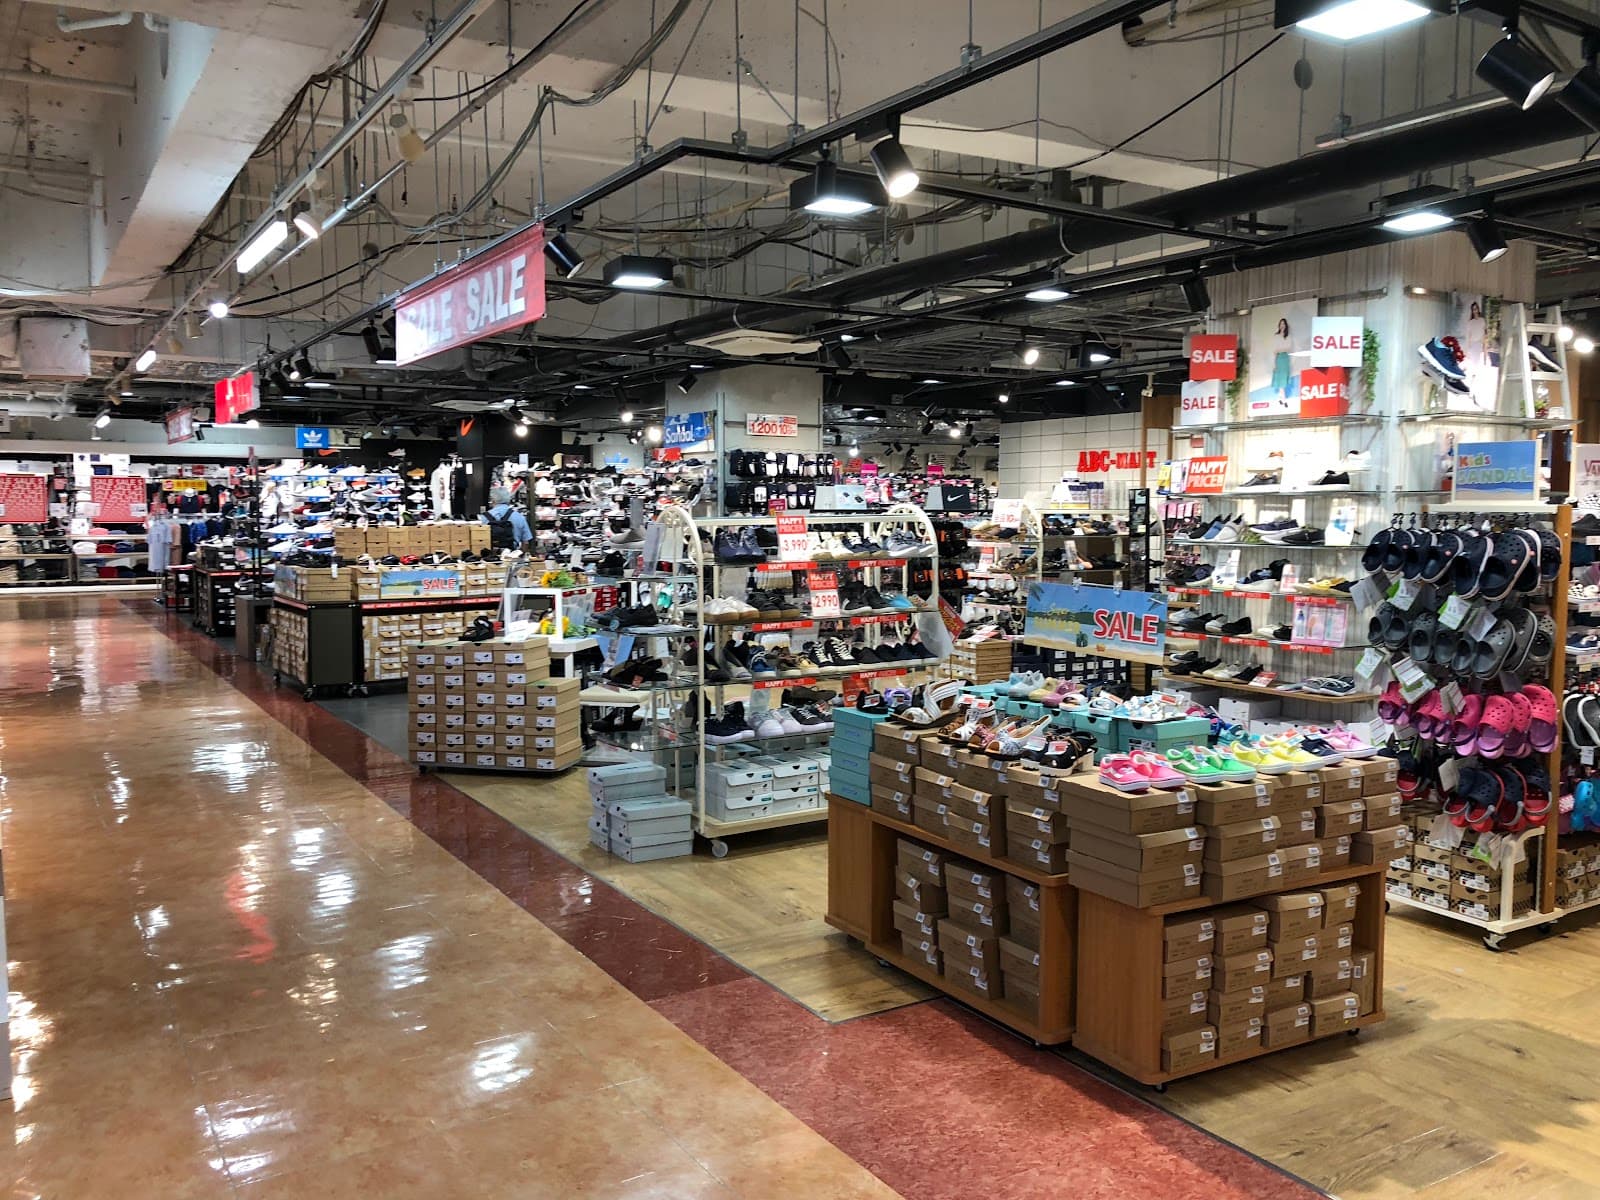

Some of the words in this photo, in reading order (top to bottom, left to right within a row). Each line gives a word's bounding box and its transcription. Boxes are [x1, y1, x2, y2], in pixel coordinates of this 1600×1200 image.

[465, 254, 527, 331] SALE
[1312, 335, 1361, 349] SALE
[1192, 349, 1236, 363] SALE
[1300, 382, 1338, 400] SALE
[1182, 396, 1216, 410] SALE
[1077, 450, 1157, 473] ABC-MAT
[1190, 460, 1228, 474] HAPPY
[1458, 453, 1491, 468] Kids
[1457, 467, 1532, 484] SANDAL
[421, 577, 457, 591] SALE
[1092, 608, 1160, 645] SALE
